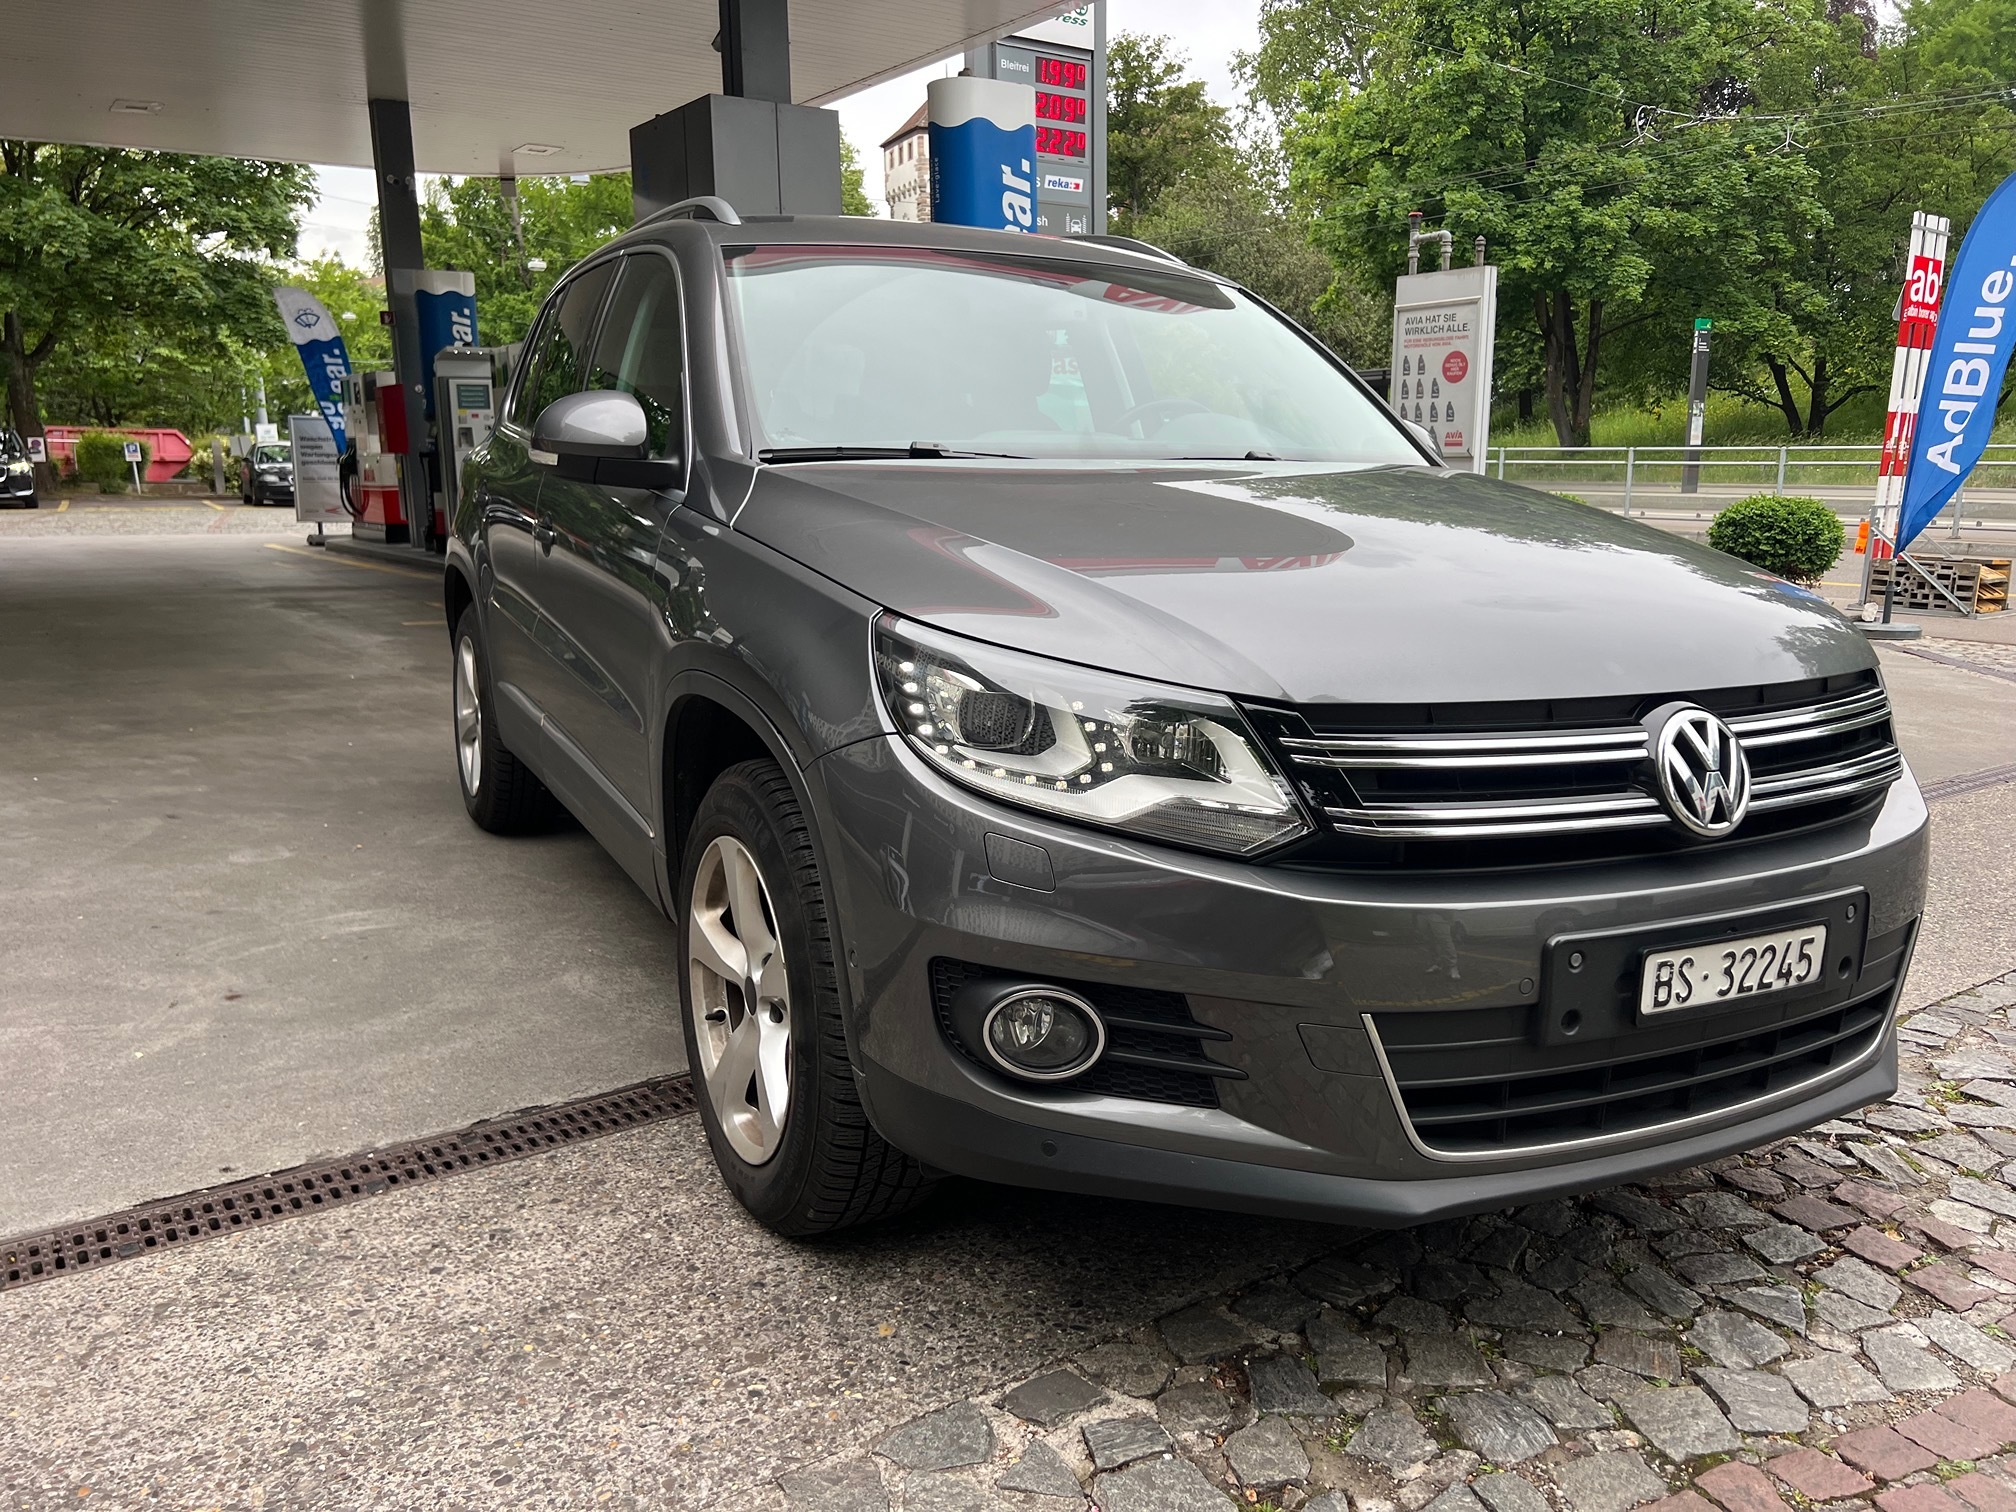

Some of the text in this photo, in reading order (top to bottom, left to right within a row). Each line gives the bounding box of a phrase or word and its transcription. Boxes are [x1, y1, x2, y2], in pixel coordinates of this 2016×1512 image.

[1001, 158, 1032, 232] ar.
[1910, 261, 1939, 305] ab
[450, 307, 473, 347] ar.
[1404, 323, 1470, 336] WIRKLICH ALLE.
[1405, 313, 1457, 326] AVIA HAT SIE
[1445, 430, 1462, 439] AVIA
